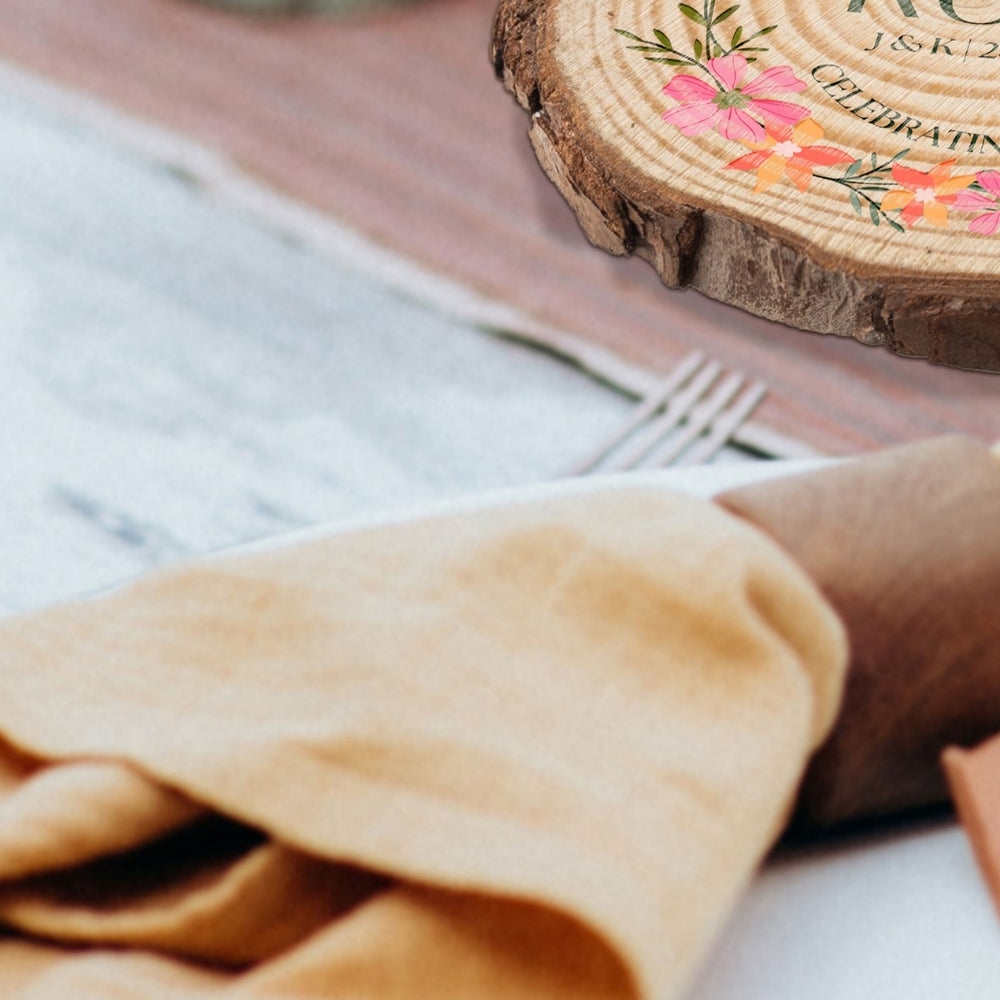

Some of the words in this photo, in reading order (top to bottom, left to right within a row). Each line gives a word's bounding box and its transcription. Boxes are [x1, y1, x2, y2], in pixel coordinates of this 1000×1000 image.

[865, 32, 884, 52] J
[890, 34, 923, 53] &
[930, 37, 955, 56] K
